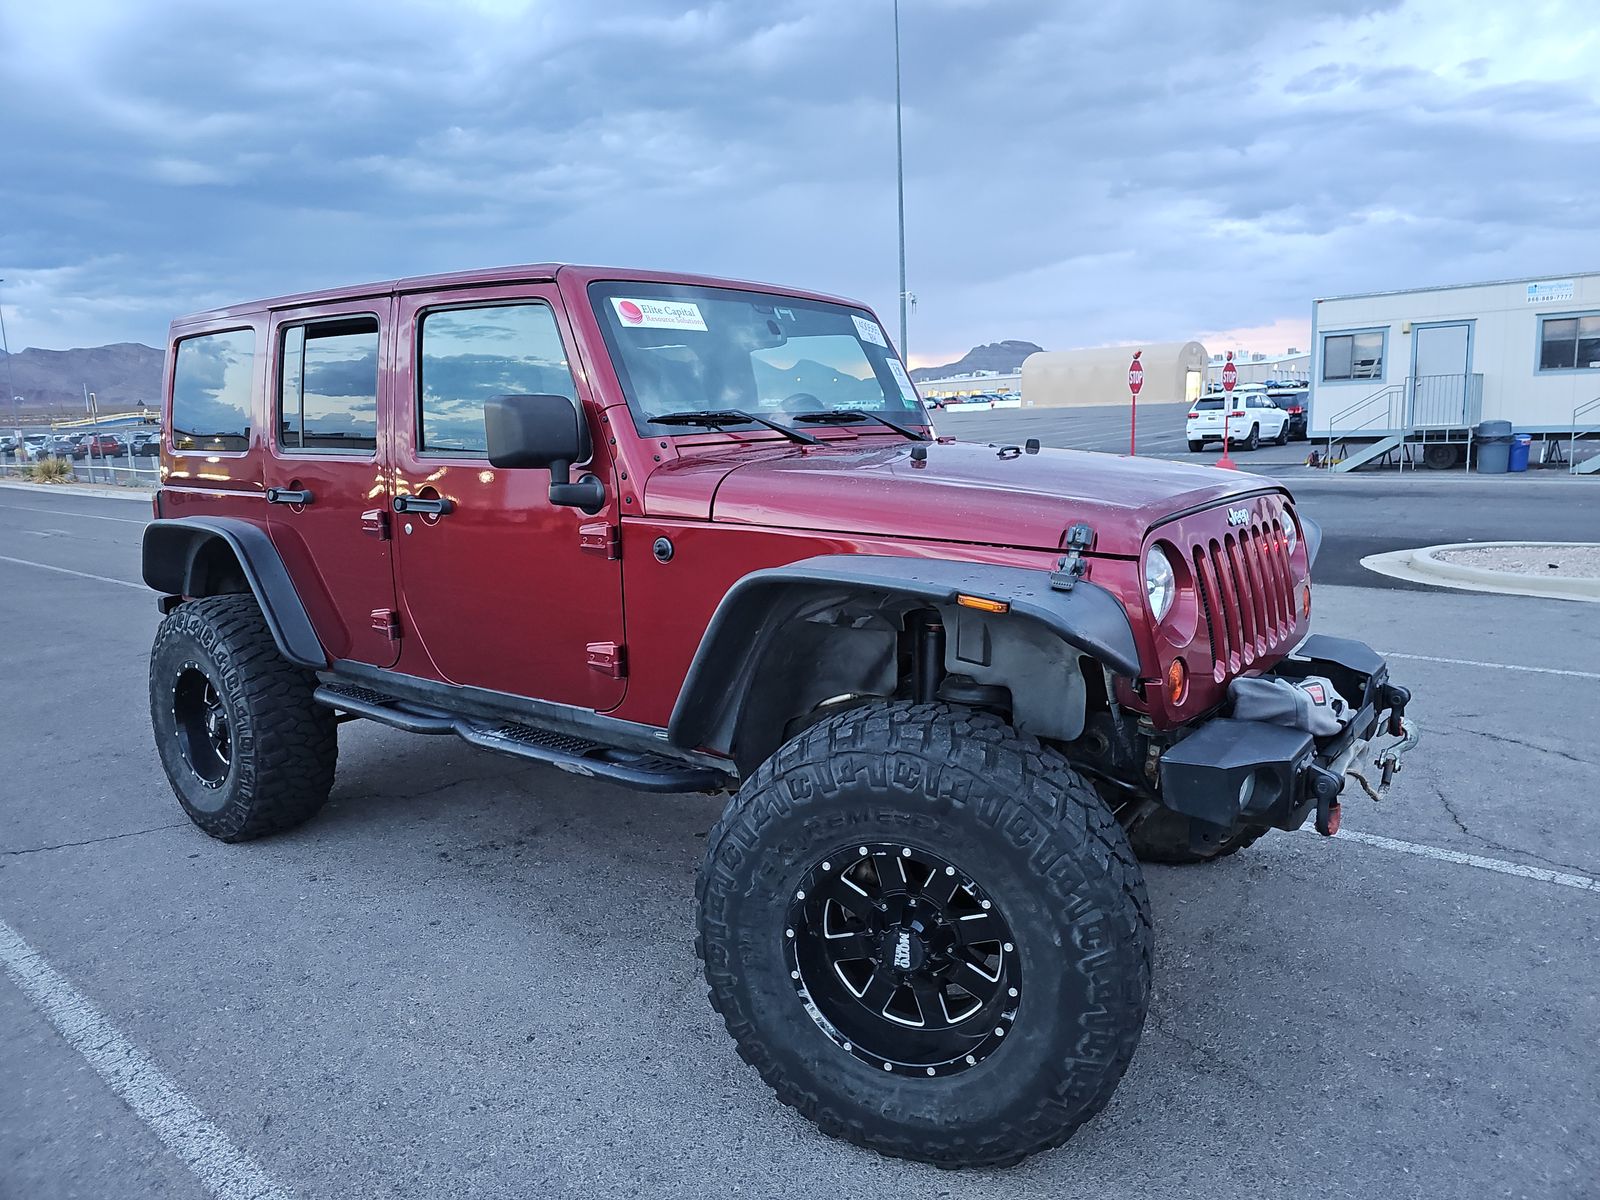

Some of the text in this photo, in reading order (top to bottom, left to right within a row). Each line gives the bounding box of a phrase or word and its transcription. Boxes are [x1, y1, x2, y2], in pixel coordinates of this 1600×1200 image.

[640, 304, 696, 318] Elite Capital
[1129, 371, 1143, 384] STOP
[1223, 371, 1237, 383] STOP
[1227, 507, 1249, 526] Jeep
[899, 932, 911, 968] MOTO
